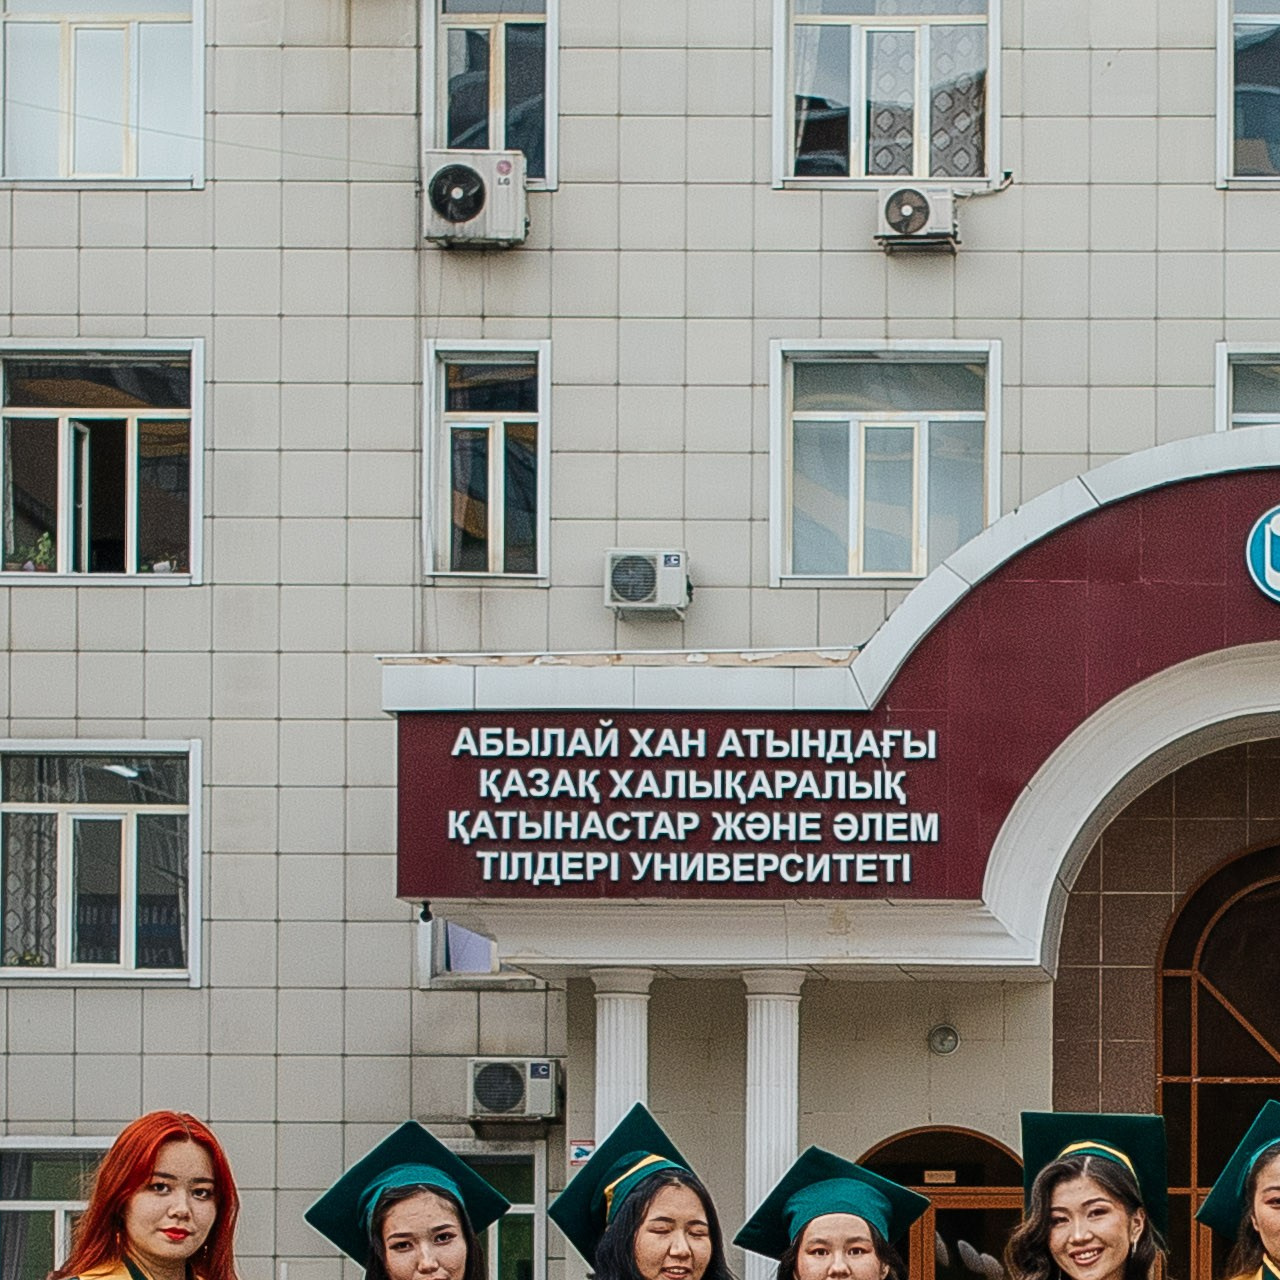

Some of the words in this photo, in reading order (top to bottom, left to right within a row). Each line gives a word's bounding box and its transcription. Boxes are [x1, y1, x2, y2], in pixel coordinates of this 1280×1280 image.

[452, 719, 618, 757] АБЫЛАЙ
[629, 729, 705, 758] ХАН
[717, 729, 936, 763] АТЫНДАҒЫ
[479, 769, 600, 803] ҚАЗАҚ
[609, 769, 907, 804] ХАЛЫҚАРАЛЫҚ
[448, 810, 700, 844] ҚАТЫНАСТАР
[712, 811, 821, 841] ЖӘНЕ
[833, 812, 939, 842] ӘЛЕМ
[477, 850, 619, 886] ТІЛДЕРІ
[630, 851, 911, 883] УНИВЕРСИТЕТІ
